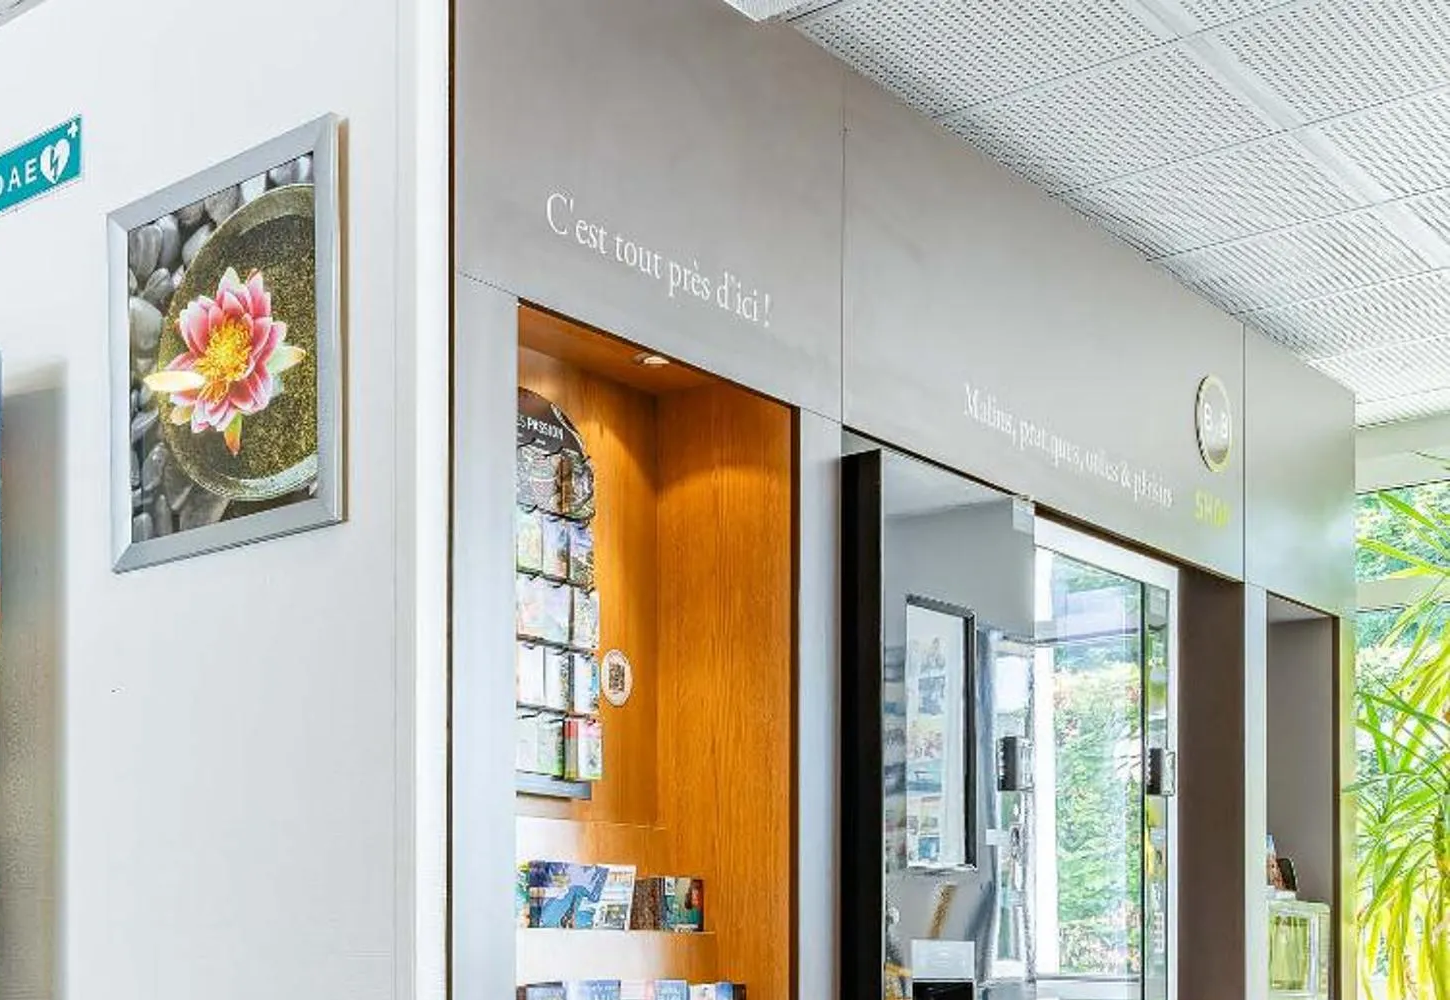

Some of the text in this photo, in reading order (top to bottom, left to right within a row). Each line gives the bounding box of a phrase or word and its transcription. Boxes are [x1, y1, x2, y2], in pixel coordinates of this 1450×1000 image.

[546, 193, 607, 254] C'est
[614, 235, 663, 279] tout
[669, 259, 711, 298] près
